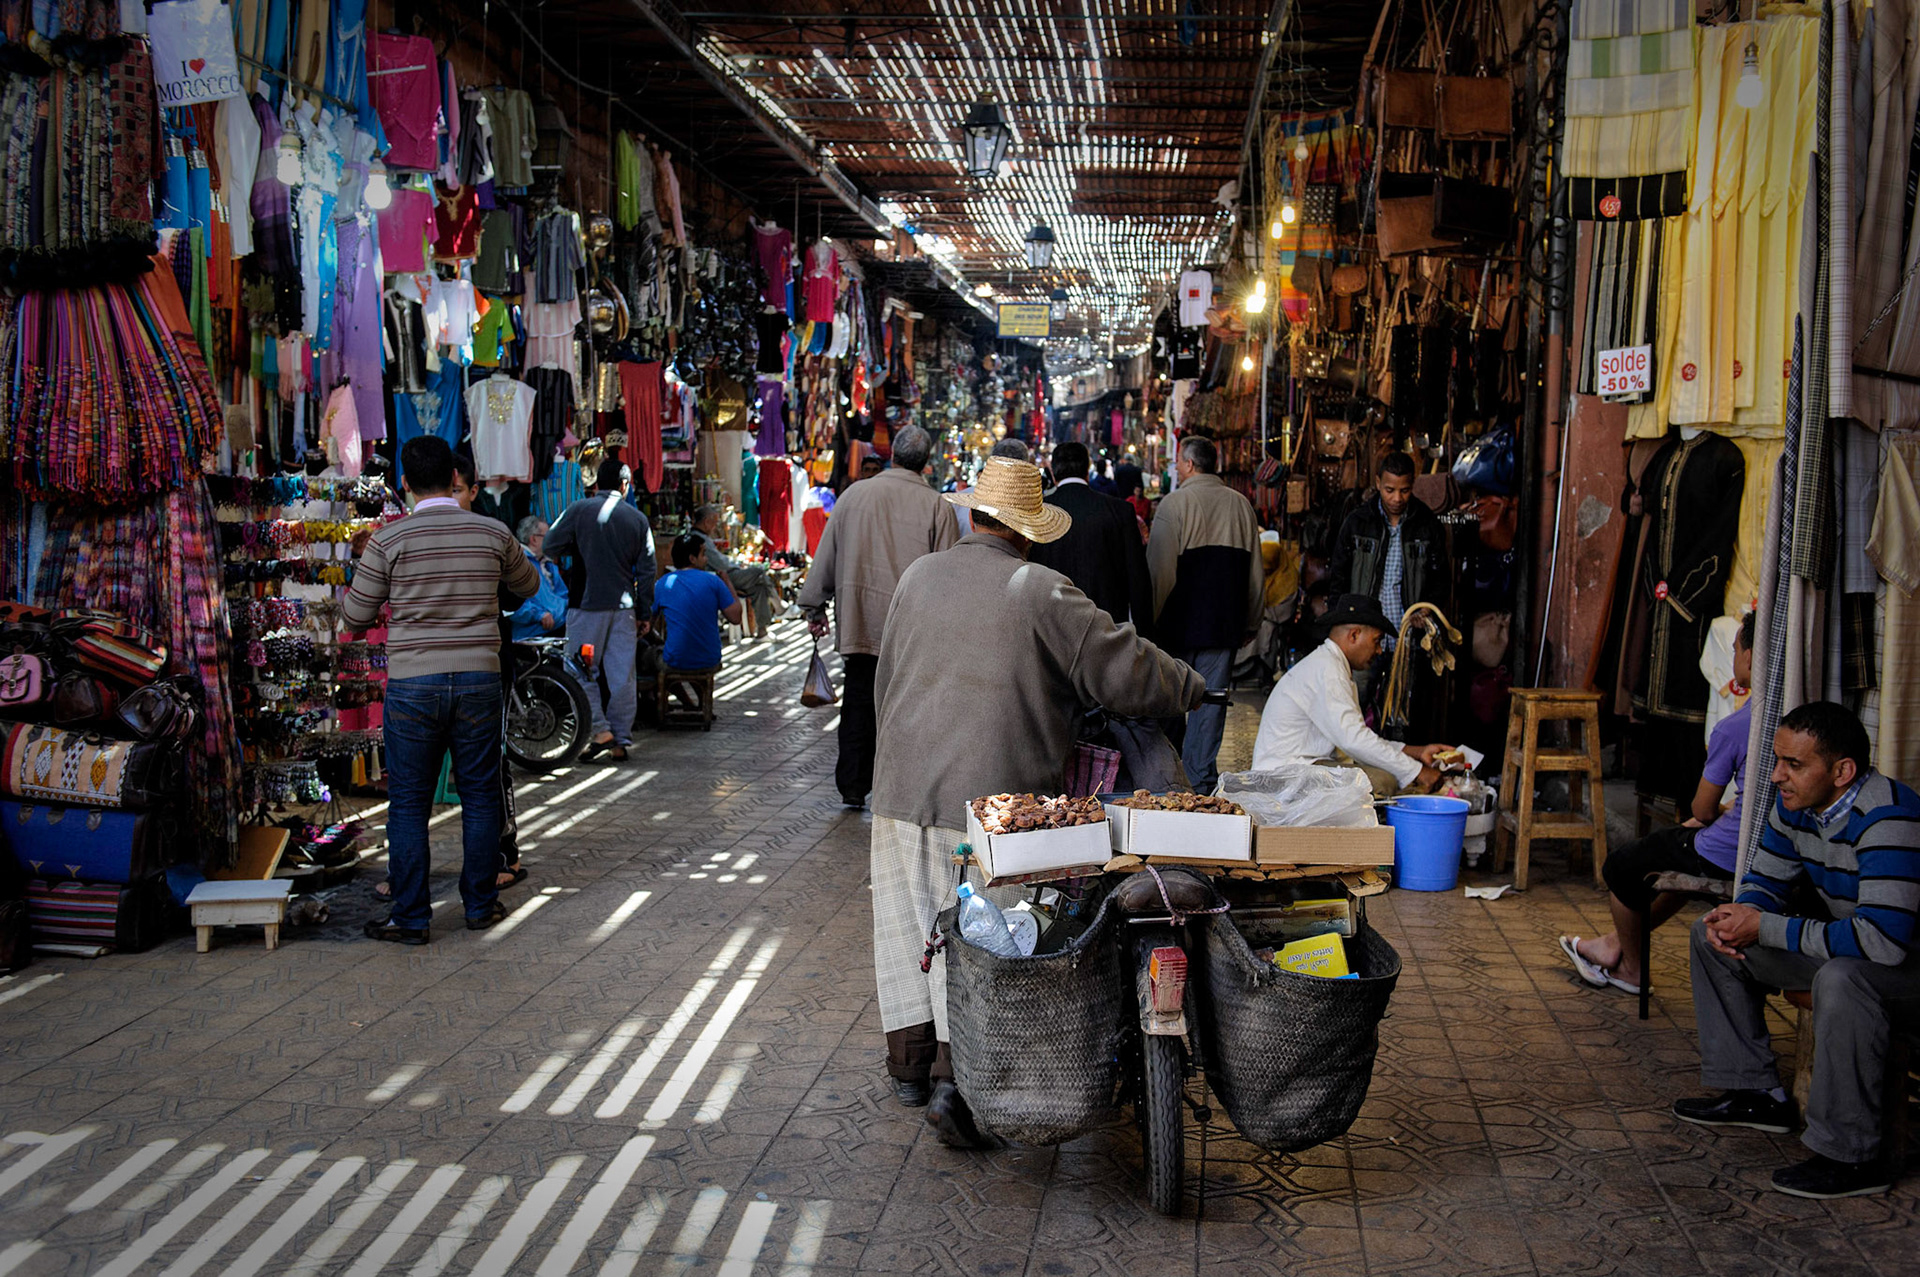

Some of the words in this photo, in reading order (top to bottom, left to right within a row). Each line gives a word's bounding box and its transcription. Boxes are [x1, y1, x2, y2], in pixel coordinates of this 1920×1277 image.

[181, 60, 189, 77] I
[1601, 349, 1646, 375] solde
[1601, 374, 1645, 392] -50%
[1312, 946, 1334, 958] Dattes
